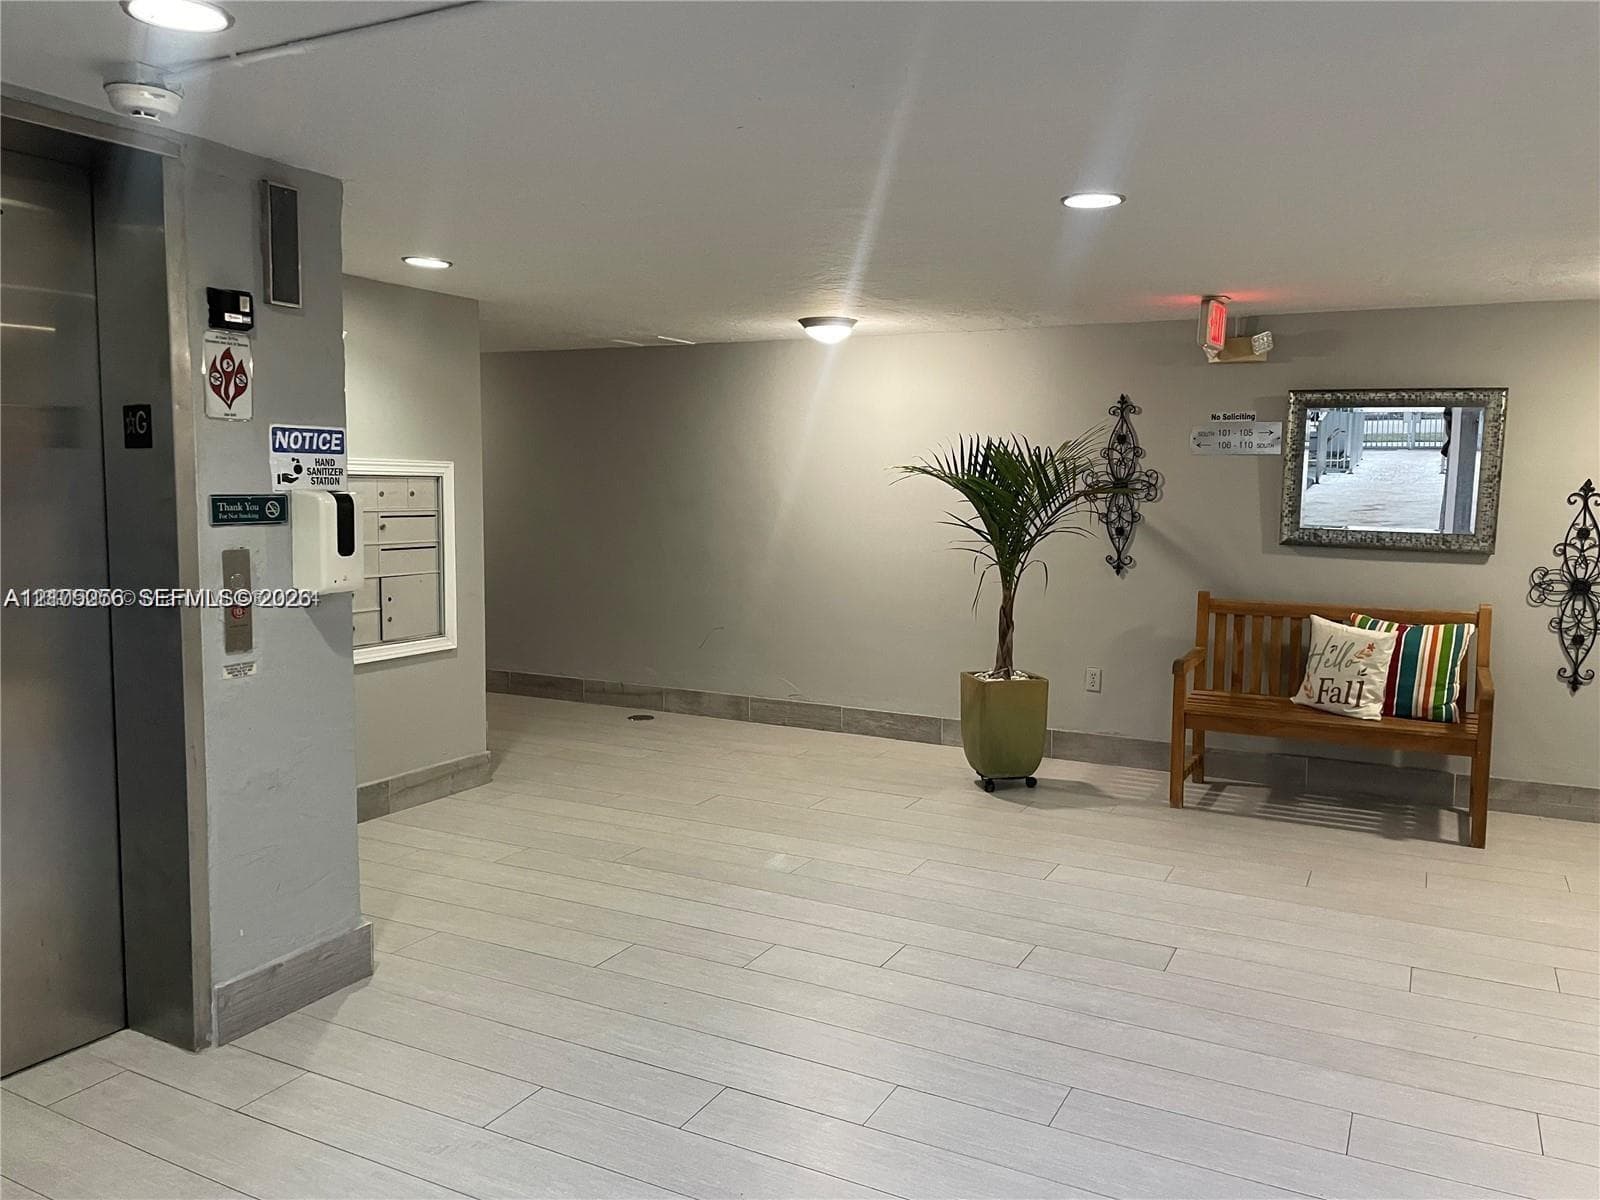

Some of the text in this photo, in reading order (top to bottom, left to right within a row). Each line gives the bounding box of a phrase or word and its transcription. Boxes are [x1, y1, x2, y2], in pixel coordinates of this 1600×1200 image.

[1211, 412, 1256, 421] No Soliciting
[1218, 429, 1231, 437] 101
[1240, 429, 1254, 437] 105
[275, 430, 343, 451] NOTICE
[1240, 441, 1254, 449] 110
[314, 458, 336, 467] HAND
[306, 467, 344, 476] SANITIZER
[310, 477, 340, 486] STATION
[217, 502, 259, 511] Thank You
[1308, 634, 1361, 674] Hello
[1314, 677, 1365, 708] Fall
